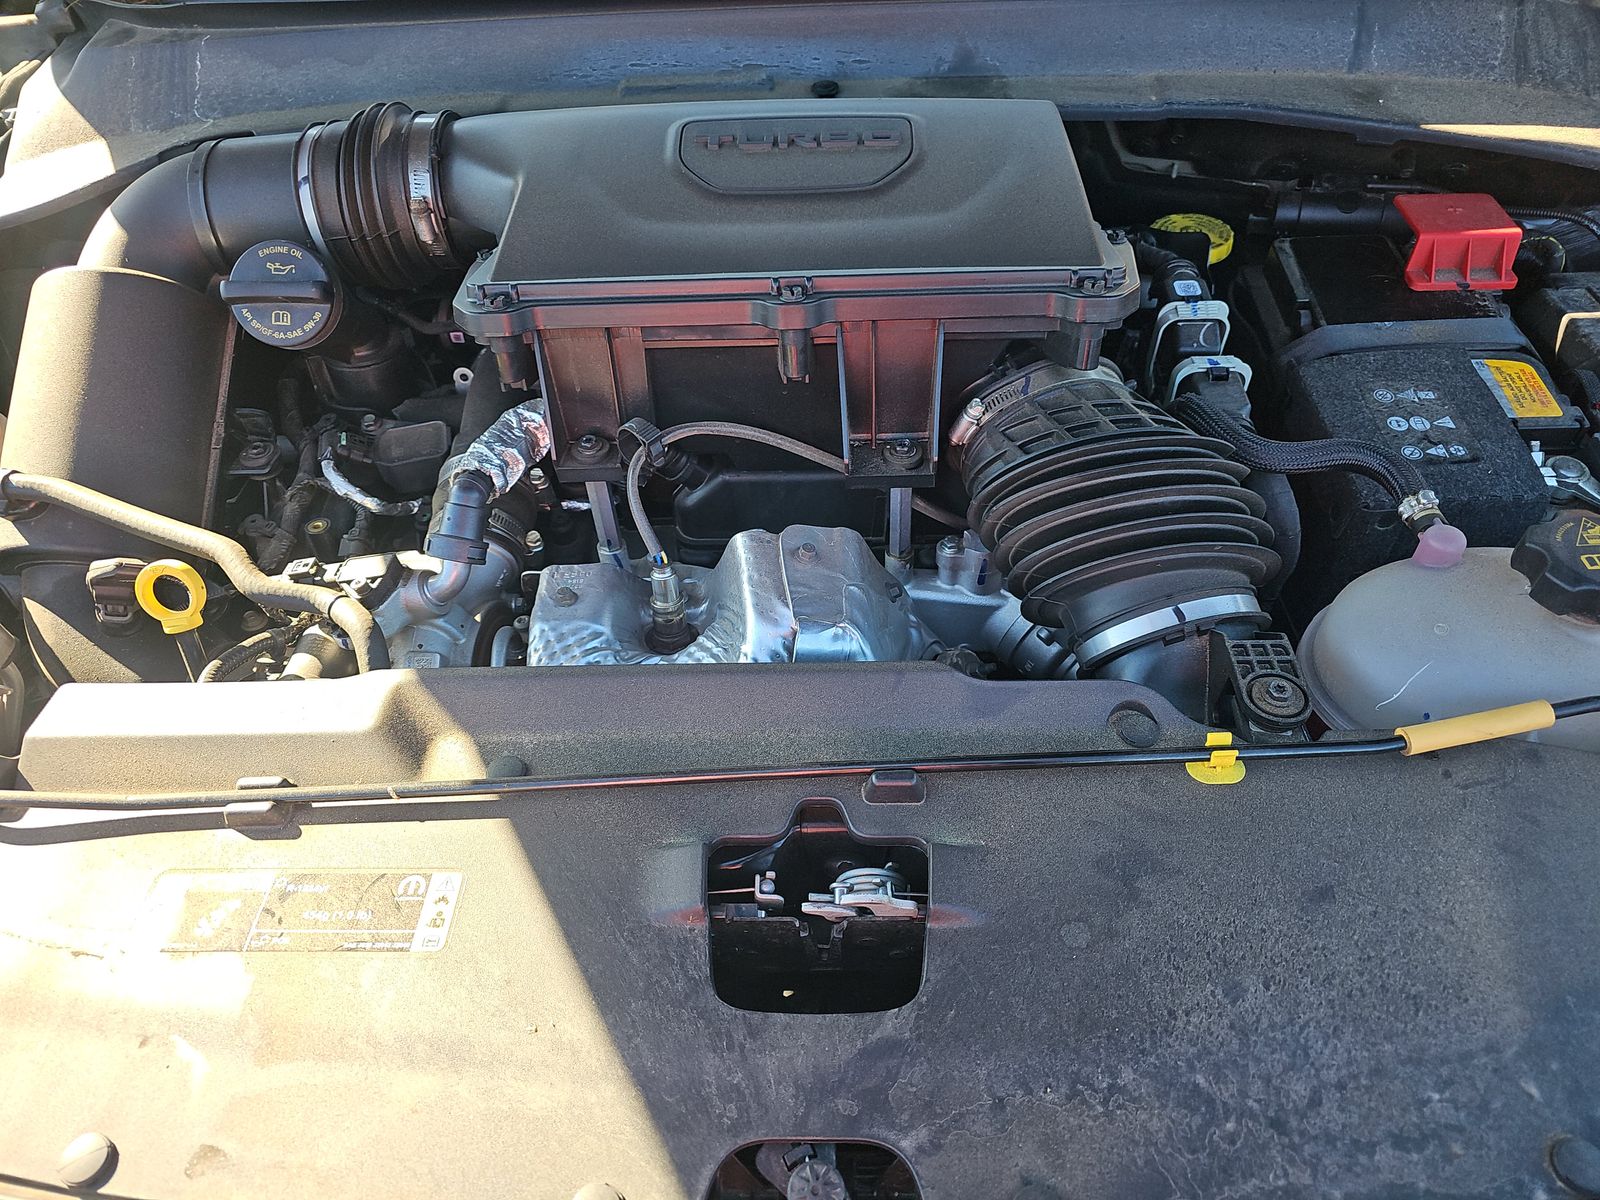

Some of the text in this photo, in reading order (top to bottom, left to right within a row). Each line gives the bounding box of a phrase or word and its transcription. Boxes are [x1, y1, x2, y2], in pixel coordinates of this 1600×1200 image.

[693, 130, 902, 151] TURBO
[258, 245, 304, 259] ENGINE OIL
[241, 308, 252, 321] API
[303, 311, 322, 332] 5W-30
